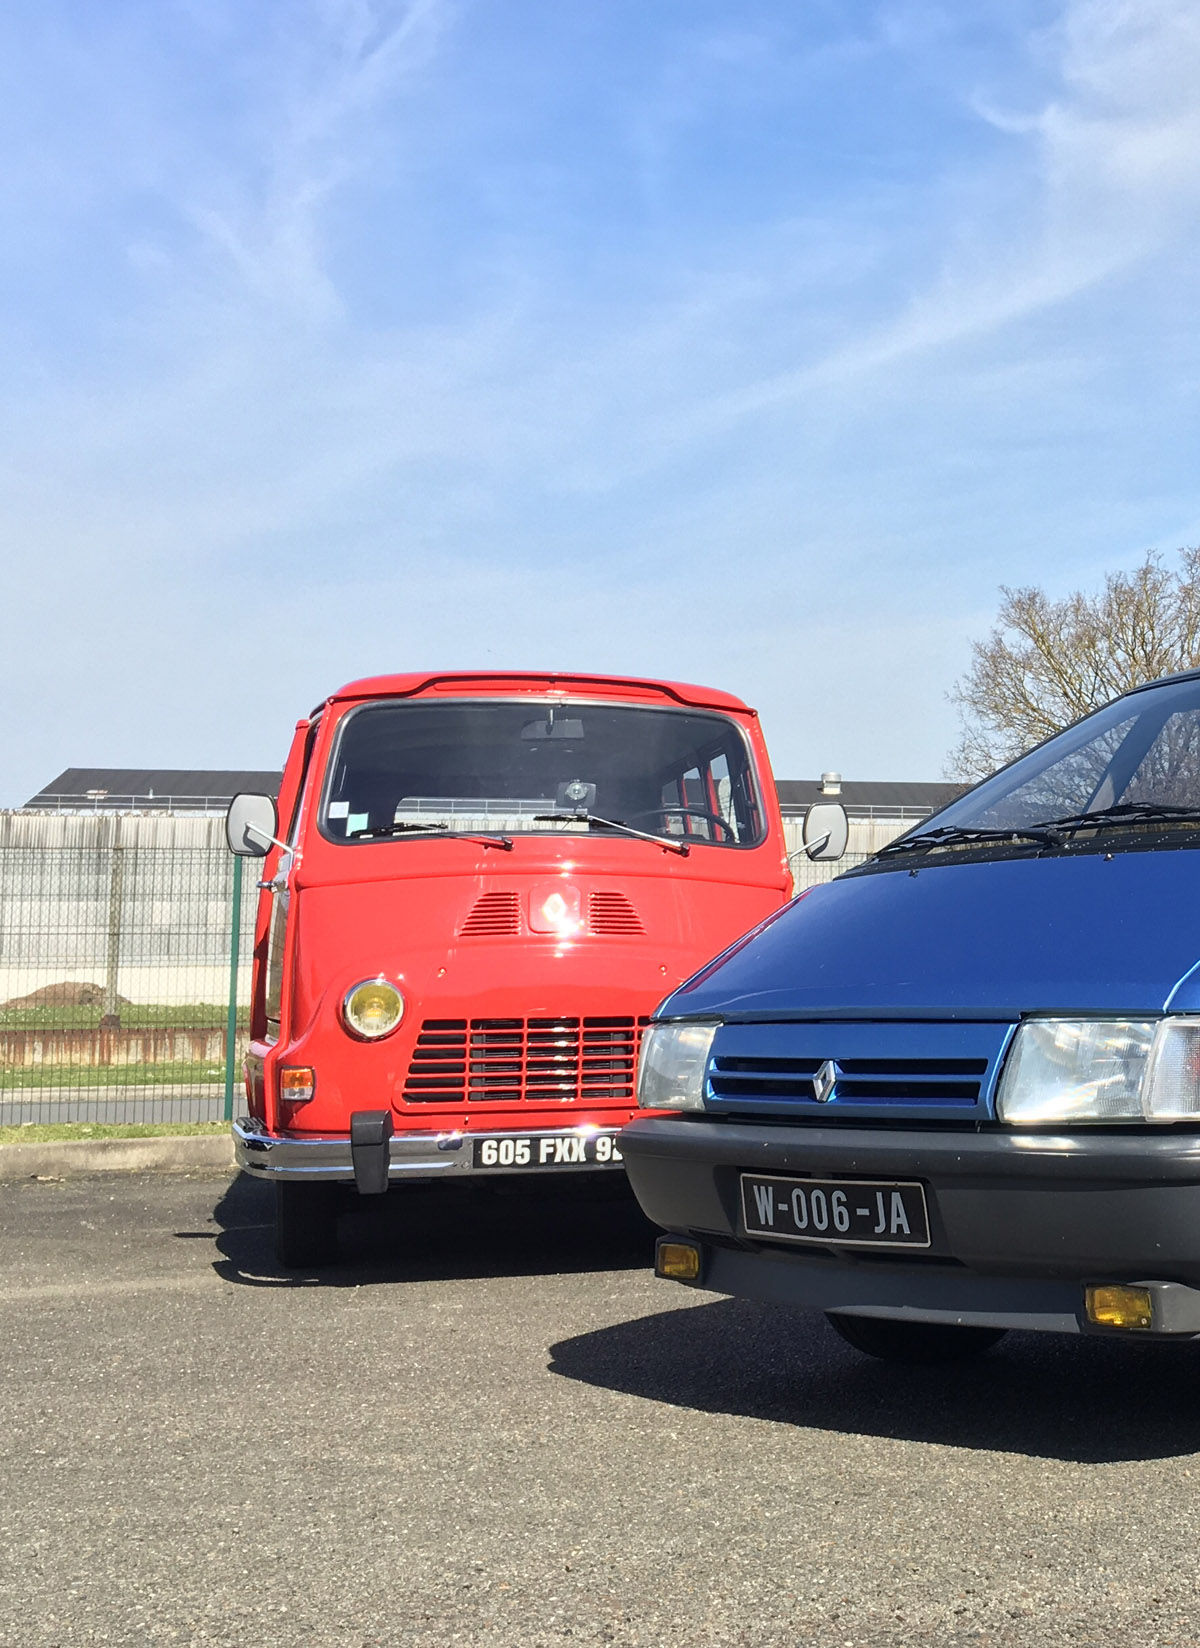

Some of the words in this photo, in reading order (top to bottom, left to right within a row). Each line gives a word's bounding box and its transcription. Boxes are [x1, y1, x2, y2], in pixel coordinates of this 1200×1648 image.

[481, 1139, 531, 1166] 605
[539, 1137, 587, 1164] FXX
[753, 1184, 911, 1234] W-006-JA
